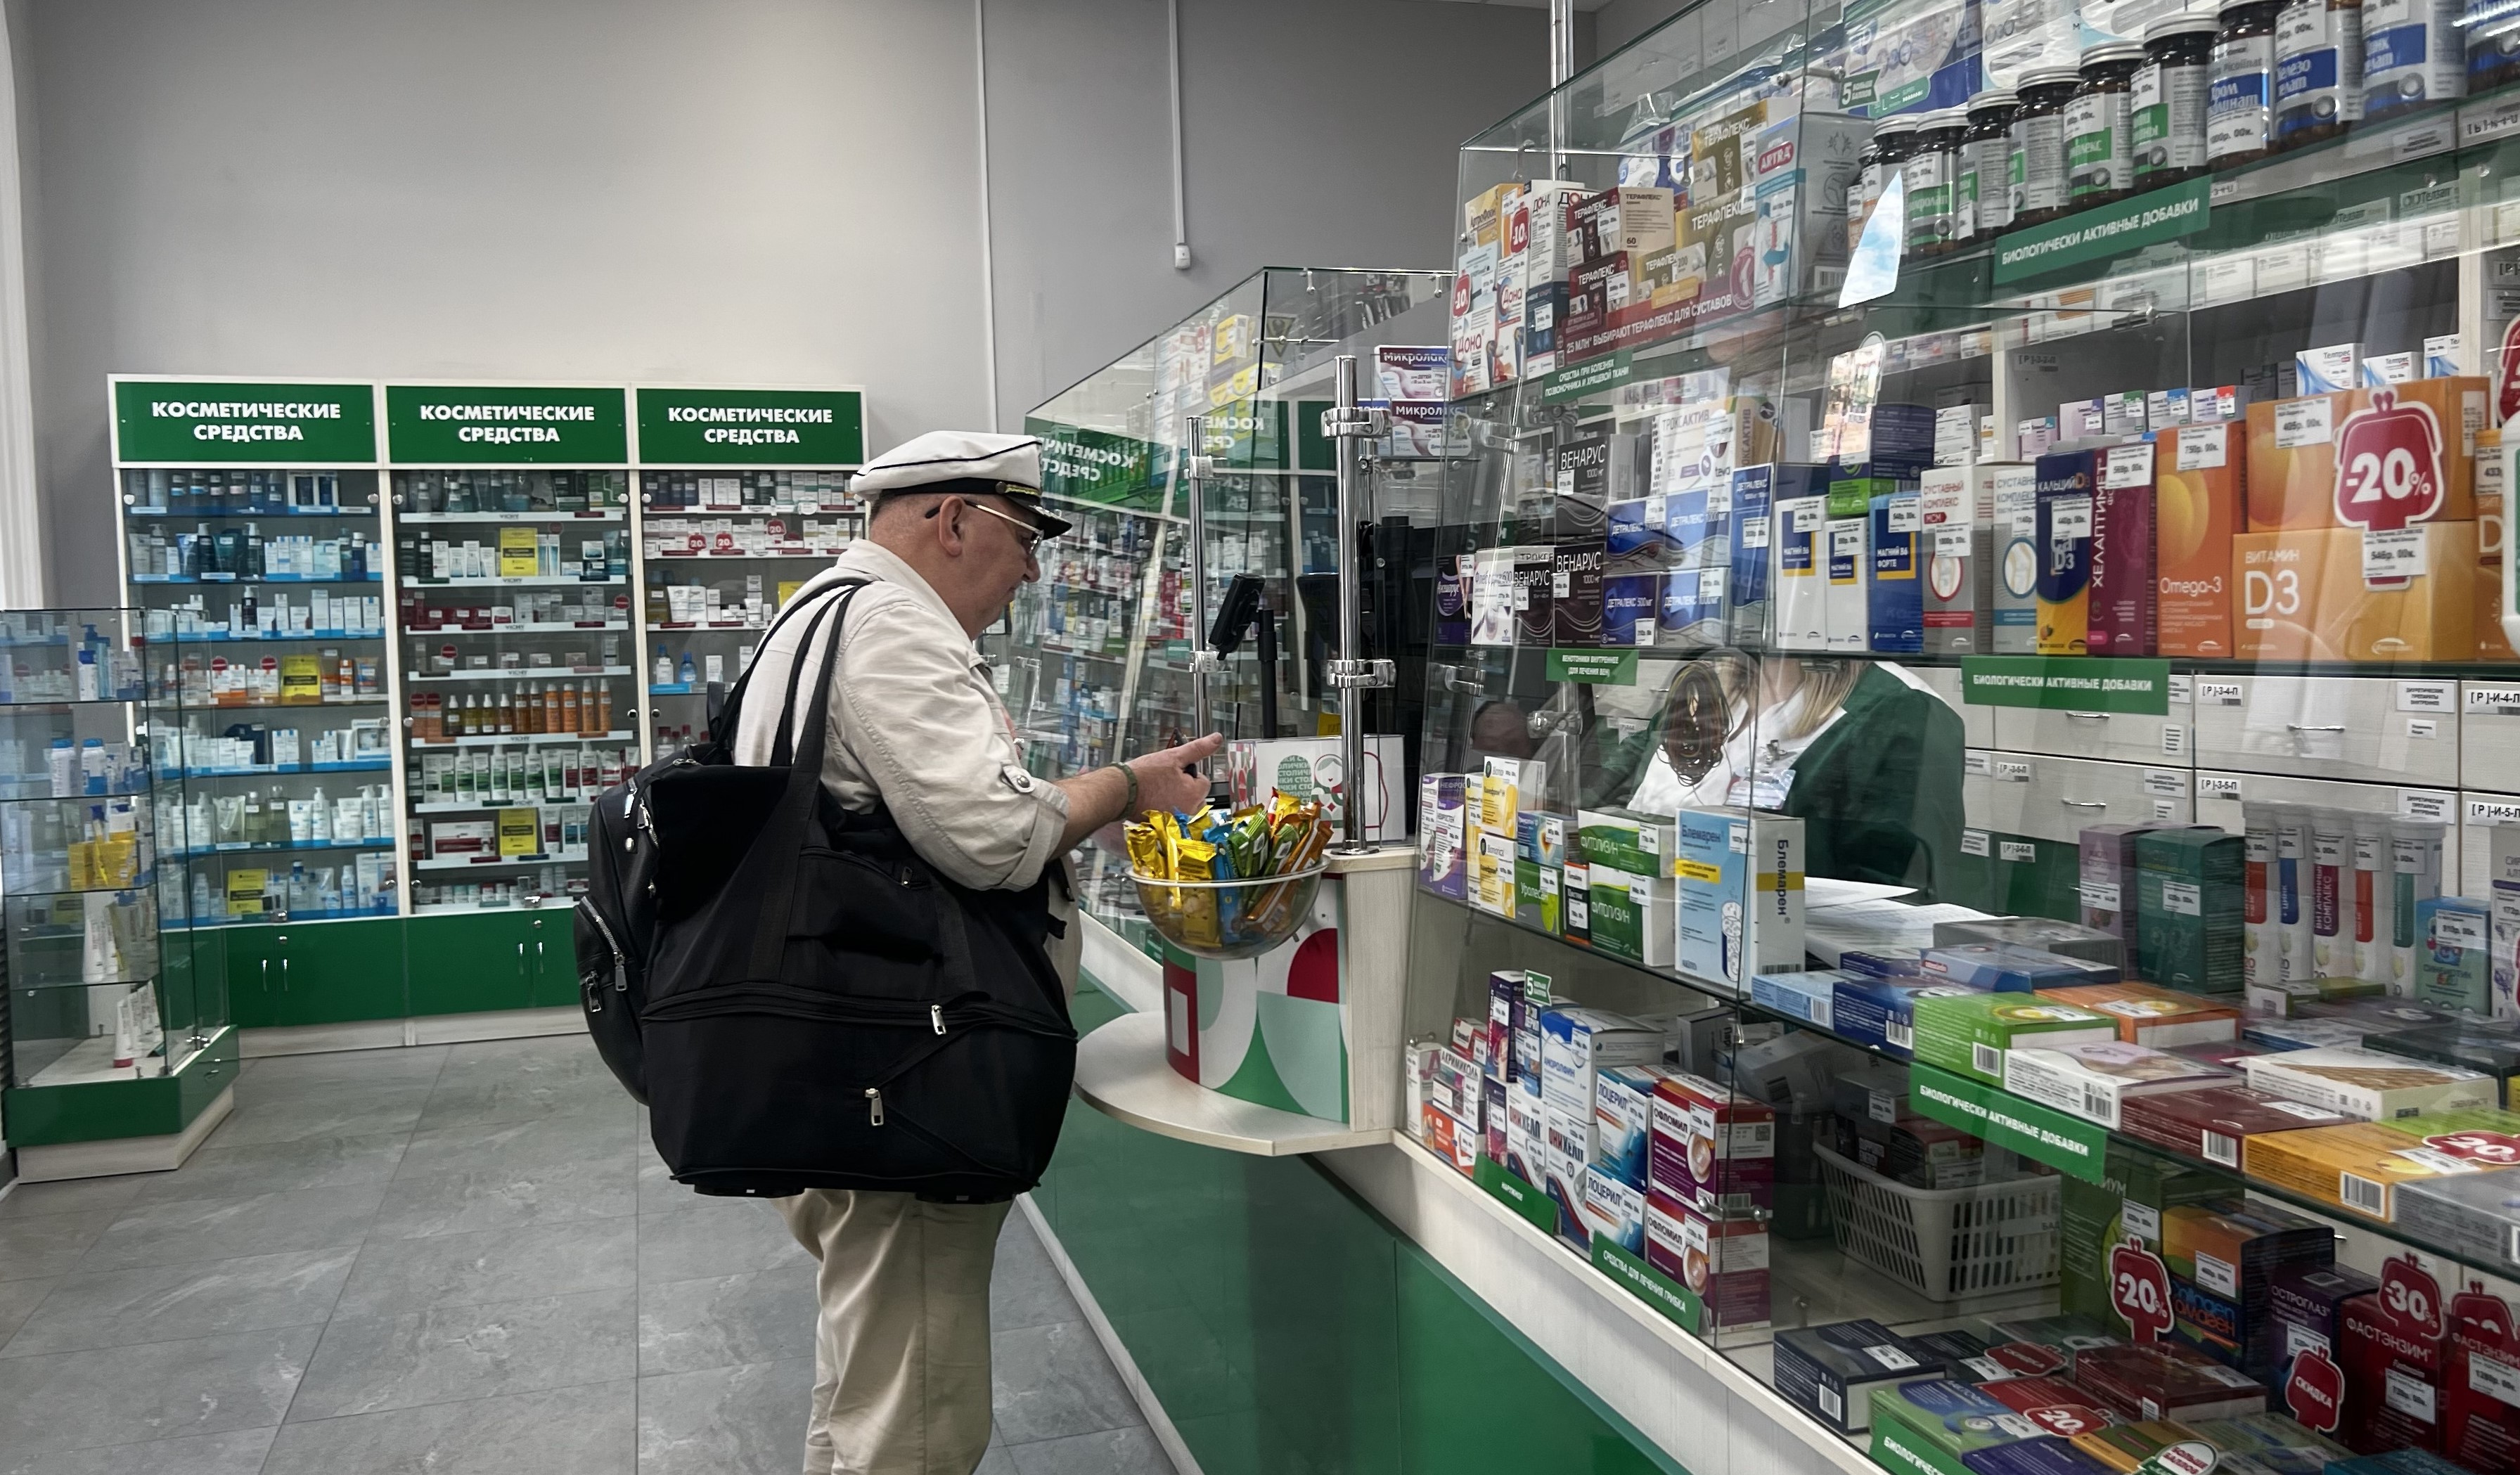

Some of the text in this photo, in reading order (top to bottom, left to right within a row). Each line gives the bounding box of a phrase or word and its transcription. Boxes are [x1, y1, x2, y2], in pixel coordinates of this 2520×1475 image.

[1841, 82, 1852, 105] 5
[1704, 119, 1751, 148] ТЕРАФЛЕКС
[1760, 146, 1792, 171] ARTRA
[1574, 198, 1607, 219] ТЕРАФЛЕКС
[1692, 202, 1743, 231] ТЕРАФЛЕКС
[2002, 198, 2199, 265] БИОЛОГИЧЕСКИ АКТИВНЫЕ ДОБАВКИ
[1578, 263, 1616, 285] ТЕРАФЛЕКС
[1501, 287, 1524, 304] Дона
[1567, 343, 1575, 354] 25
[1593, 324, 1631, 346] ВЫБИРАЮТ
[1631, 314, 1673, 335] ТЕРАФЛЕКС
[1673, 307, 1691, 324] ДЛЯ
[1691, 295, 1732, 317] СУСТАВОВ
[1457, 333, 1481, 354] Дона
[1612, 366, 1630, 378] ТКАНИ
[152, 401, 341, 419] КОСМЕТИЧЕСКИЕ
[420, 405, 595, 422] КОСМЕТИЧЕСКИЕ
[668, 407, 832, 423] КОСМЕТИЧЕСКИЕ
[1662, 409, 1710, 430] ТРОКСАКТИВ
[193, 425, 304, 443] СРЕДСТВА
[458, 426, 560, 444] СРЕДСТВА
[704, 428, 800, 446] СРЕДСТВА
[1741, 408, 1751, 467] ОКСАКТИВ
[1561, 444, 1606, 470] ВЕНАРУС
[1715, 464, 1730, 477] teva
[2345, 448, 2431, 503] -20%
[1736, 479, 1768, 493] ДЕТРАЛЕКС
[1924, 480, 1965, 495] СУСТАВНЫЙ
[2038, 476, 2075, 492] КАЛЬЦИЙ
[1924, 497, 1959, 509] КОМПЛЕКС
[1612, 522, 1643, 536] ДЕТРАЛЕКС
[1671, 514, 1704, 529] ДЕТРАЛЕКС
[2091, 460, 2107, 588] ХЕЛАПТИМЕТ
[1784, 546, 1802, 555] МАГНИЙ
[1877, 547, 1897, 557] МАГНИЙ
[2244, 548, 2299, 563] ВИТАМИН
[1557, 550, 1601, 574] ВЕНАРУС
[1877, 558, 1897, 568] ФОРТЕ
[1515, 569, 1550, 587] ВЕНАРУС
[2159, 575, 2223, 596] Omega-3
[1664, 595, 1697, 608] ДЕТРАЛЕКС
[2244, 569, 2300, 615] D3
[1607, 598, 1637, 610] ДЕТРАЛЕКС
[1973, 674, 2153, 692] БИОЛОГИЧЕСКИ АКТИВНЫЕ ДОБАВКИ
[1681, 824, 1721, 844] Блемарен
[1581, 837, 1619, 855] ФИТОЛИЗИН
[1775, 839, 1789, 916] Блемарен
[1591, 901, 1631, 924] ФИТОЛИЗИН
[1527, 976, 1534, 996] 5
[1598, 1082, 1629, 1112] ЛОЦЕРИЛ
[1509, 1104, 1541, 1138] ОНИХЕЛП
[1654, 1107, 1688, 1133] ОФЛОМИЛ
[1919, 1084, 1988, 1122] БИОЛОГИЧЕСКИ
[1988, 1109, 2039, 1140] АКТИВНЫЕ
[2040, 1128, 2089, 1157] ДОБАВКИ
[1548, 1127, 1584, 1164] ОНИХЕЛП
[1588, 1177, 1622, 1208] ЛОЦЕРИЛ
[1647, 1216, 1683, 1245] ОФЛОМИЛ
[1664, 1289, 1686, 1313] ГРИБКА
[2116, 1272, 2168, 1318] -20%
[2271, 1285, 2329, 1317] ОСТРОГЛАЗ
[2384, 1280, 2438, 1328] -30%
[2346, 1318, 2431, 1363] ФАСТЭНЗИМ
[2452, 1332, 2520, 1369] ФАСТЭНЗИМ
[2295, 1376, 2333, 1409] СКИДКА
